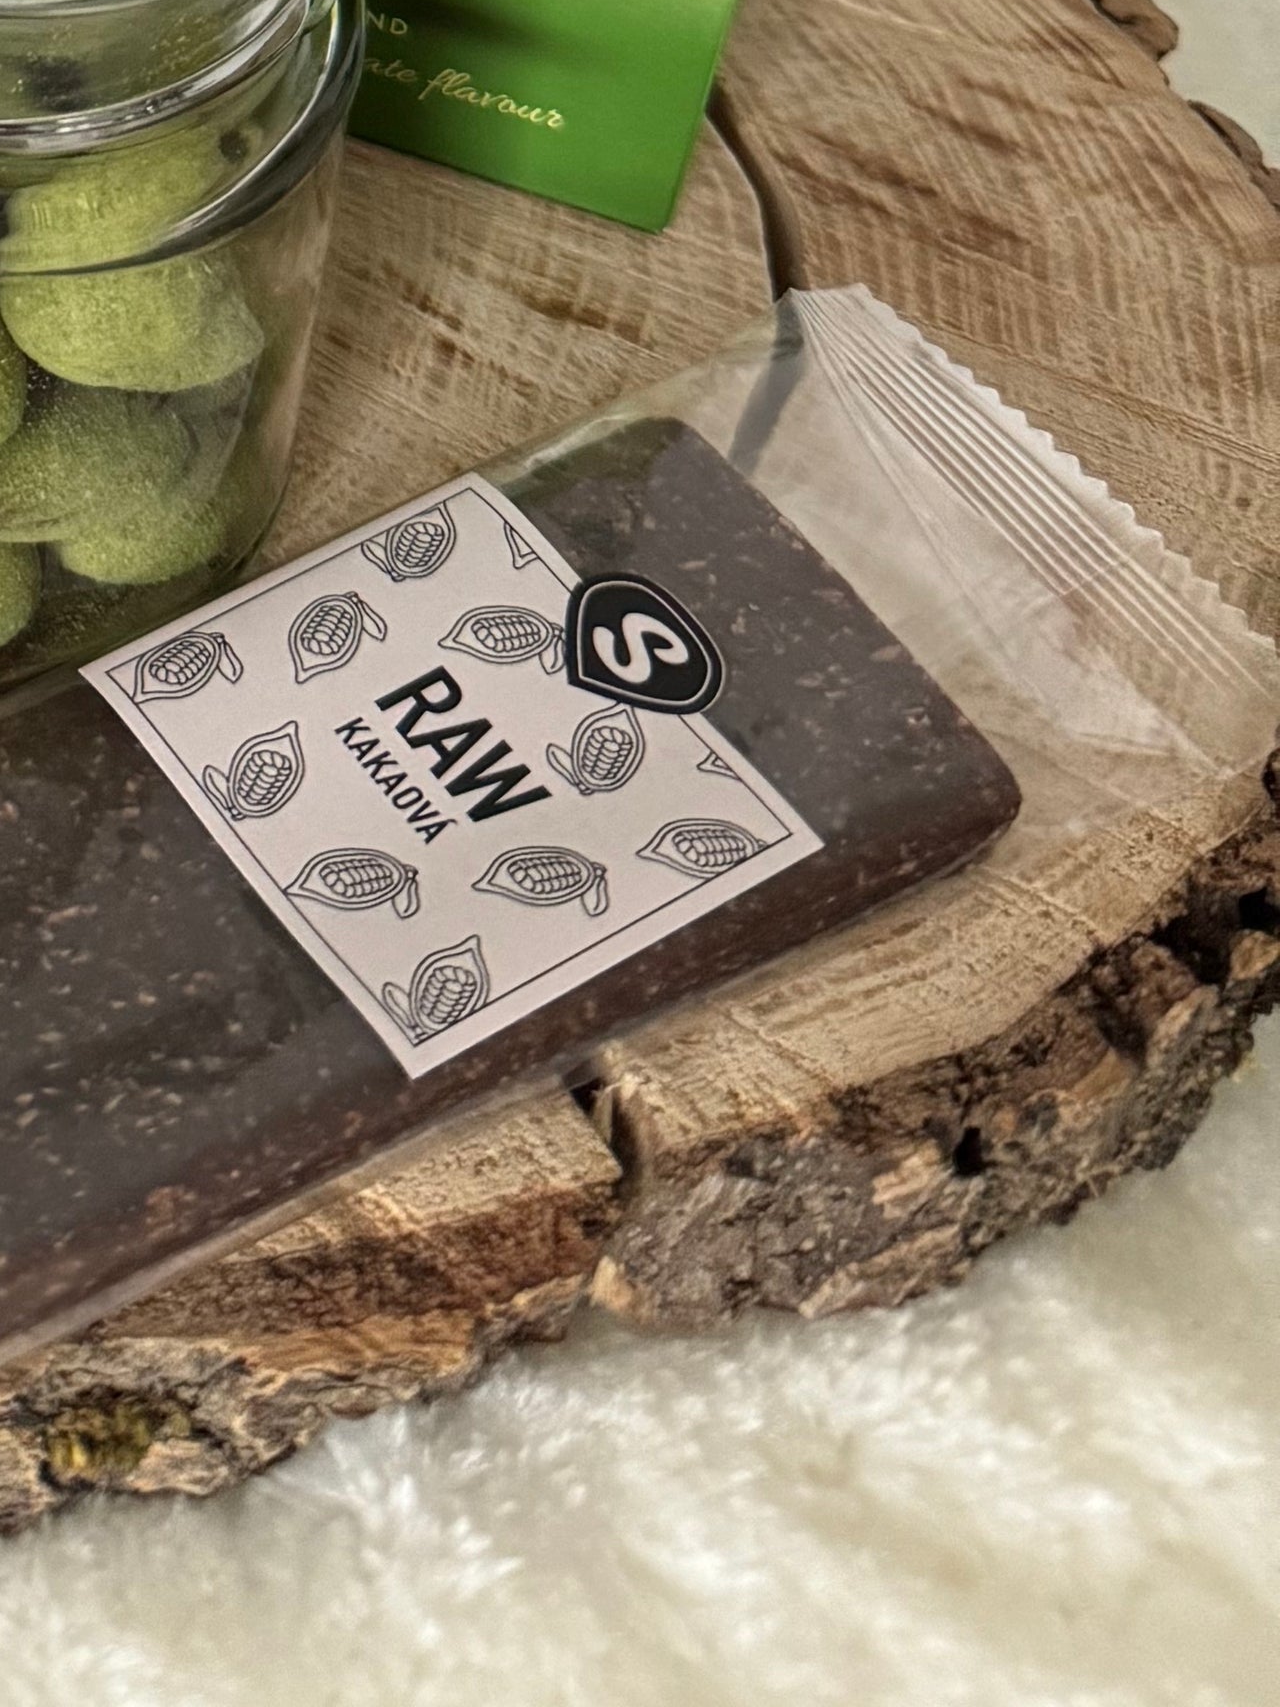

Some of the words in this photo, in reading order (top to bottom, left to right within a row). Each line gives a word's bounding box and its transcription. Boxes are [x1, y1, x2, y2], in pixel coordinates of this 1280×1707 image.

[418, 68, 565, 129] flavour
[333, 716, 458, 845] KAKAOVÁ
[374, 665, 553, 823] RAW
